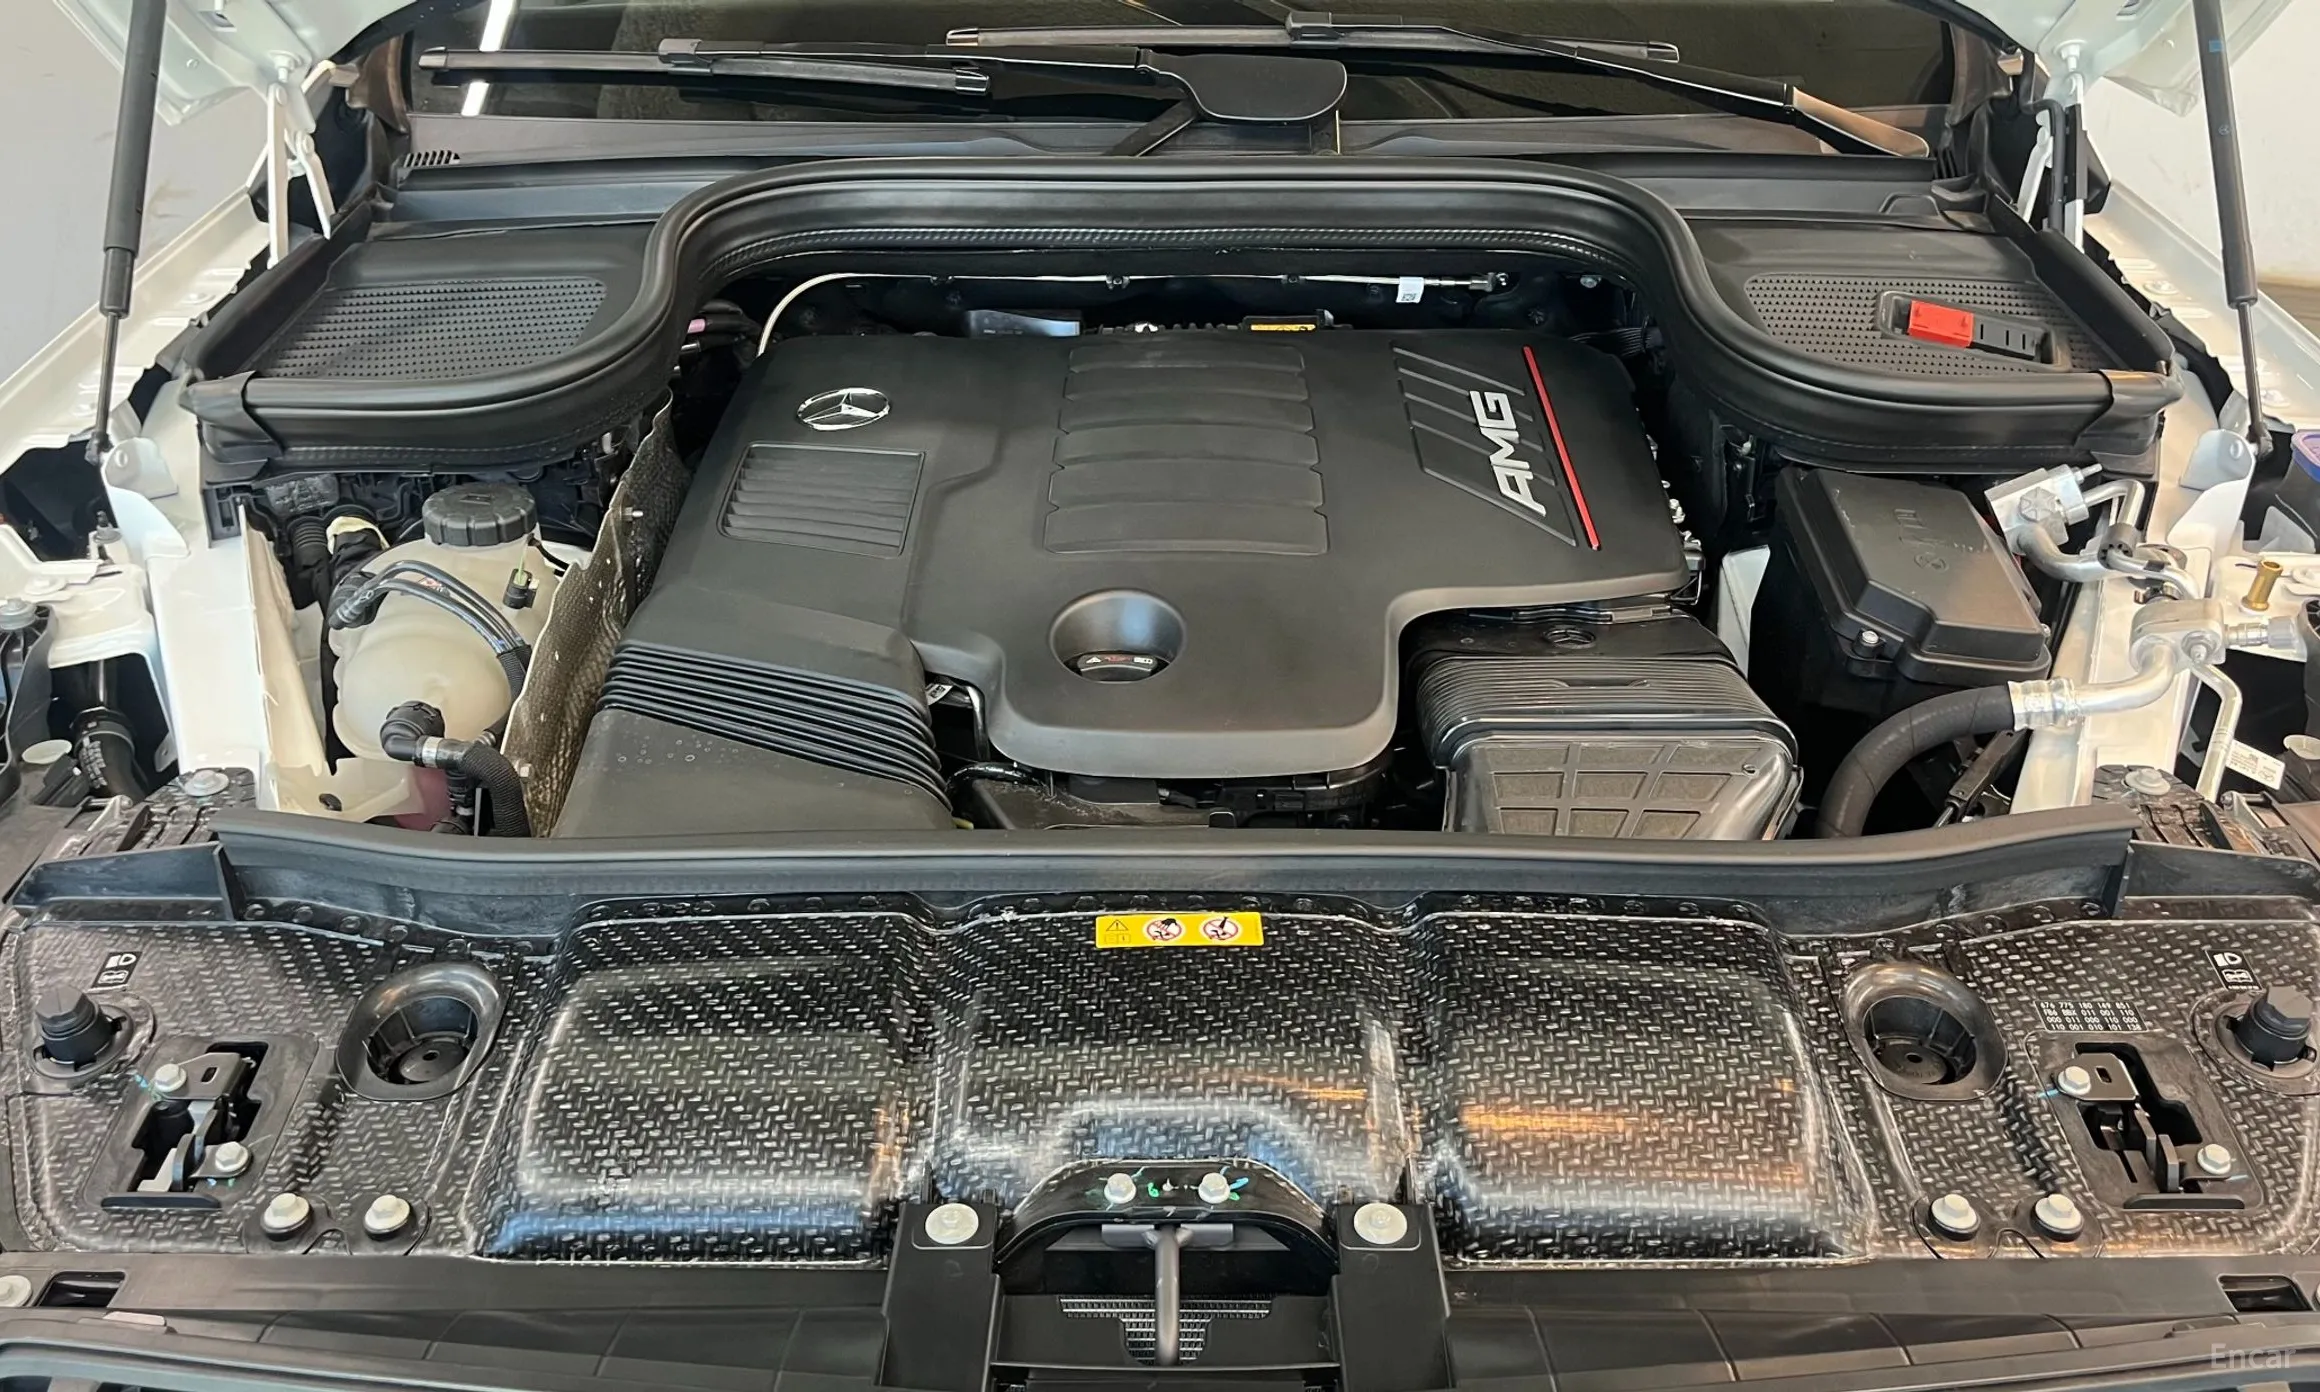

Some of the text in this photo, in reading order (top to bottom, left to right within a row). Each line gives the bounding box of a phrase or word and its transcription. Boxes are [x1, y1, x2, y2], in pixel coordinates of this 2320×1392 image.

[1469, 390, 1548, 517] AMG
[2050, 1023, 2066, 1031] 110
[2069, 1023, 2084, 1031] 001
[2088, 1023, 2104, 1031] 010
[2108, 1023, 2122, 1031] 101
